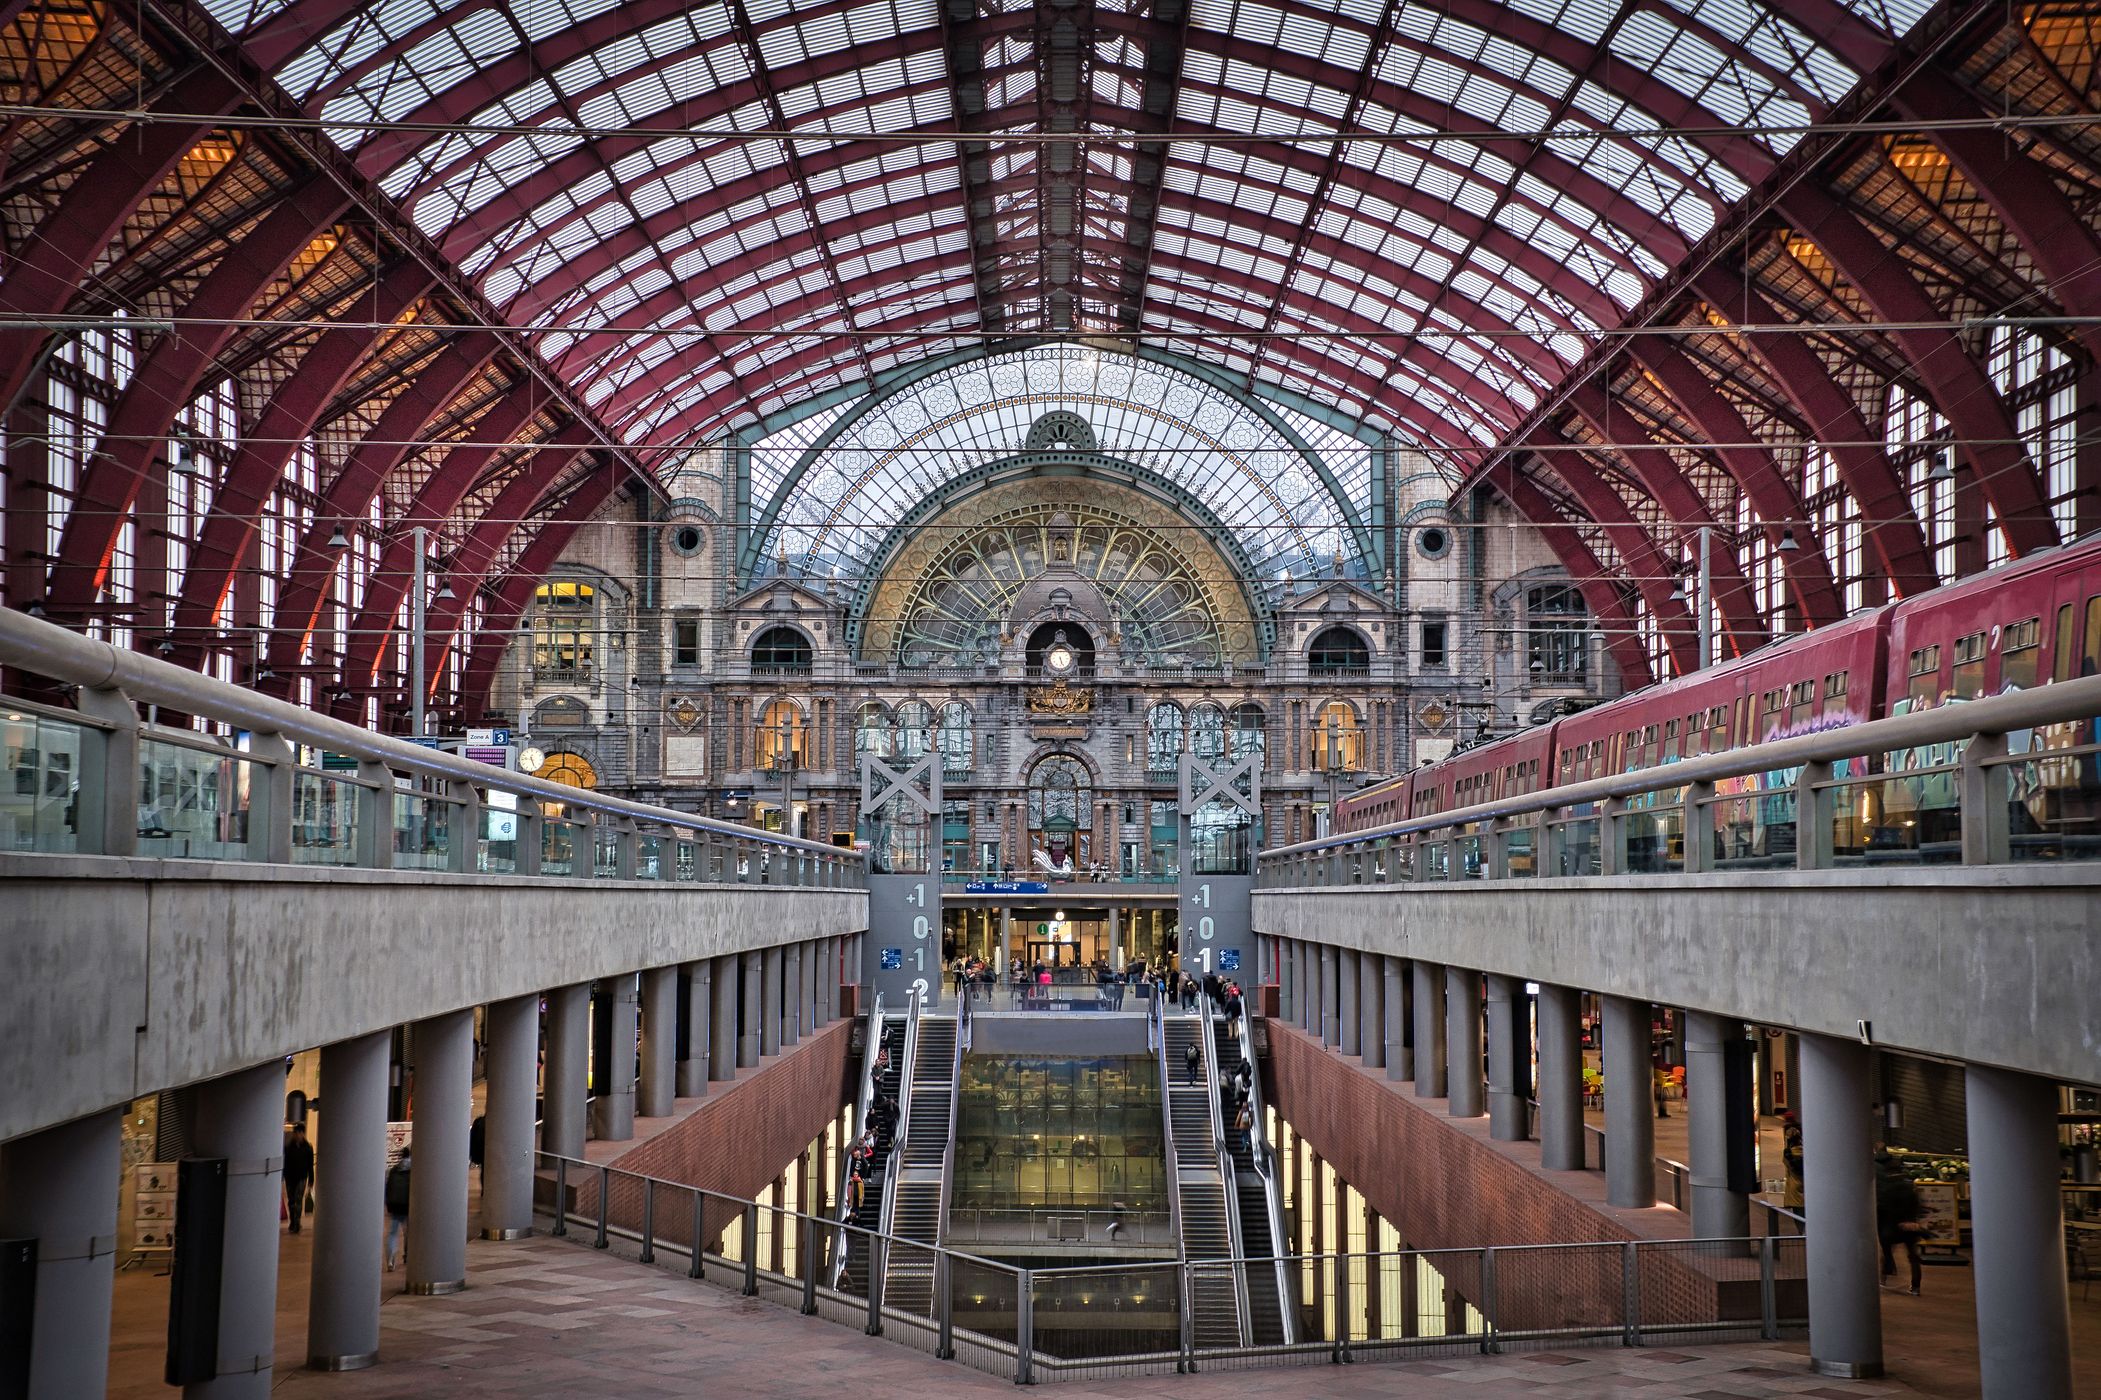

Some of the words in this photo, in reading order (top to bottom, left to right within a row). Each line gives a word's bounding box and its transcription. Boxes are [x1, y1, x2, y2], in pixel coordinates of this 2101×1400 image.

[1785, 683, 1791, 707] 2
[1704, 707, 1710, 730] 2
[497, 733, 504, 742] 3
[906, 883, 925, 908] +1
[1192, 884, 1210, 909] +1
[913, 915, 929, 940] 0
[1199, 916, 1214, 940] 0
[908, 947, 924, 972] -1
[1193, 947, 1211, 973] -1
[905, 978, 929, 1004] -2
